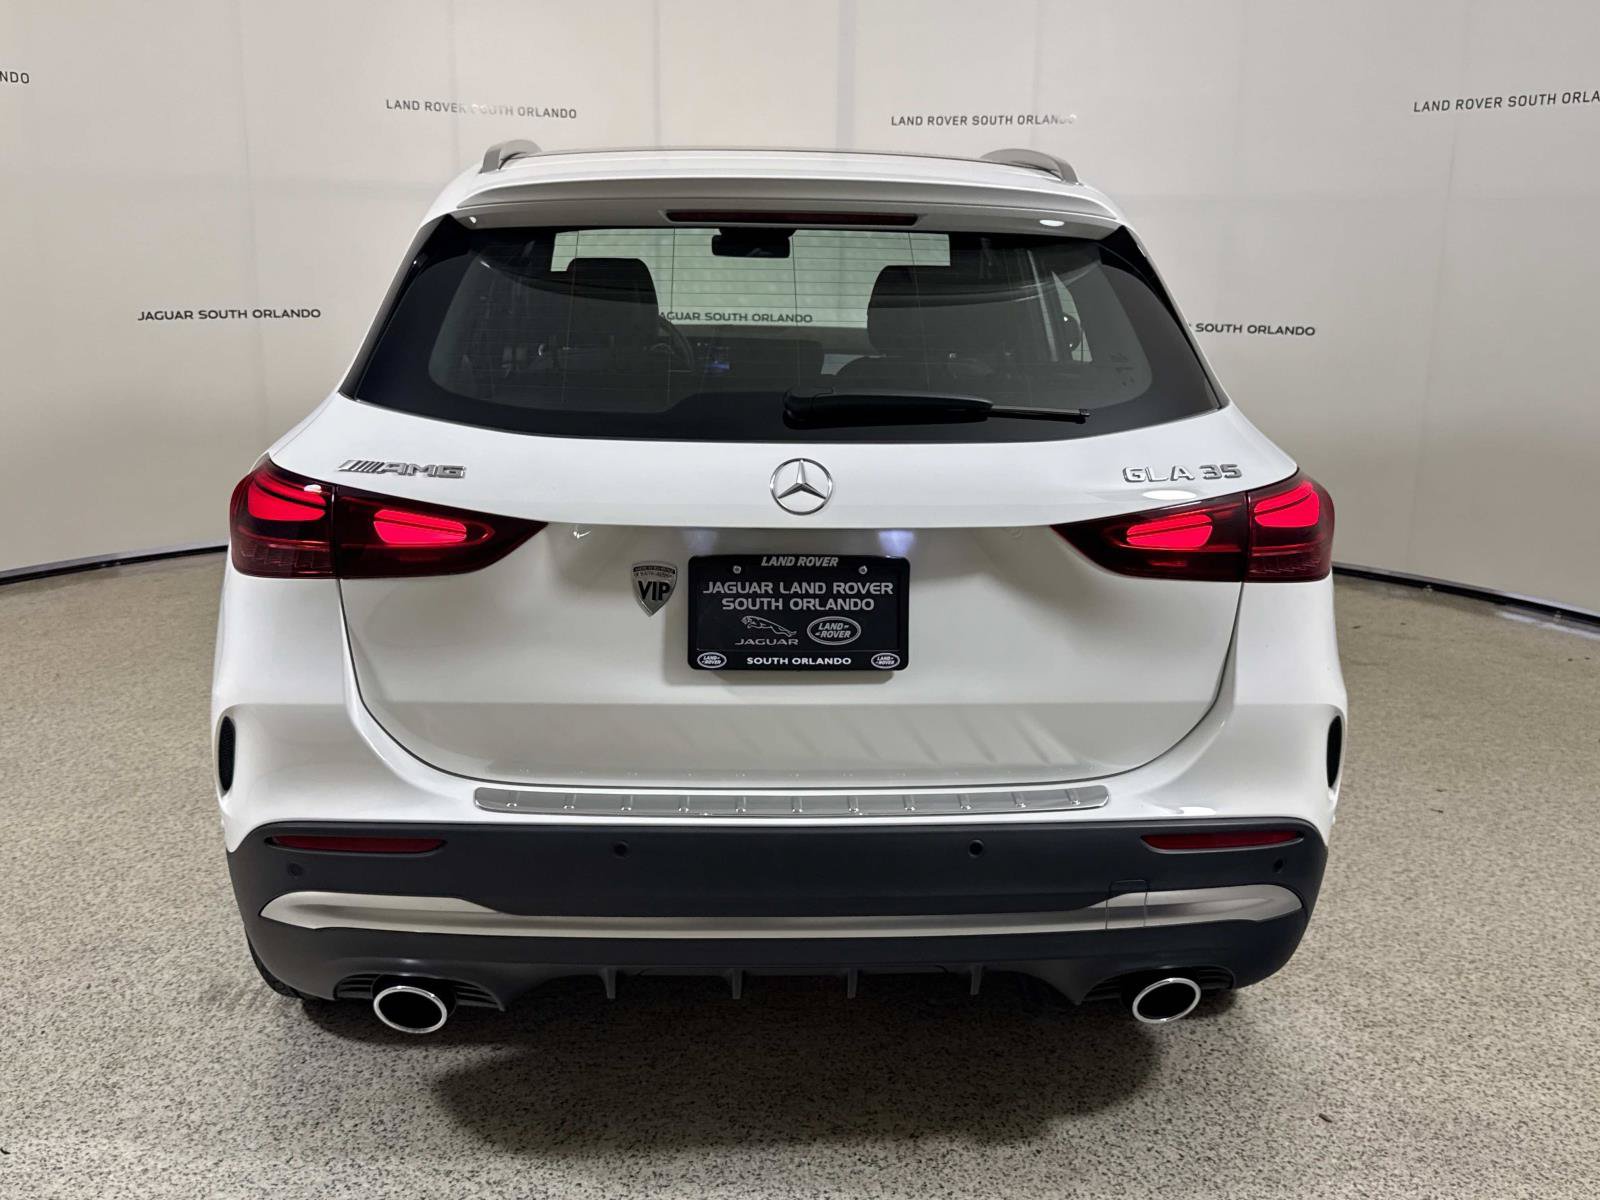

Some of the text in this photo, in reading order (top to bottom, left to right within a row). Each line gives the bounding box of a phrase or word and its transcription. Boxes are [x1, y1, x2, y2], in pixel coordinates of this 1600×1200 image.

[386, 99, 420, 111] LAND
[517, 106, 577, 119] ORLANDO
[1413, 100, 1450, 113] LAND
[1455, 97, 1503, 110] ROVER
[1507, 93, 1557, 107] SOUTH
[891, 115, 923, 126] LAND
[927, 115, 968, 126] ROVER
[971, 115, 1013, 126] SOUTH
[137, 308, 321, 321] JAGUAR SOUTH ORLANDO
[658, 311, 813, 323] AGUAR SOUTH ORLANDO
[1195, 322, 1242, 334] SOUTH
[1246, 324, 1316, 336] ORLANDO
[1122, 463, 1242, 483] GLA 35
[761, 556, 839, 567] LAND ROVER
[637, 580, 671, 601] VIP
[703, 581, 894, 595] JAGUAR LAND ROVER
[722, 597, 875, 611] SOUTH ORLANDO
[734, 638, 799, 646] JAGUAR
[746, 656, 852, 665] SOUTH ORLANDO
